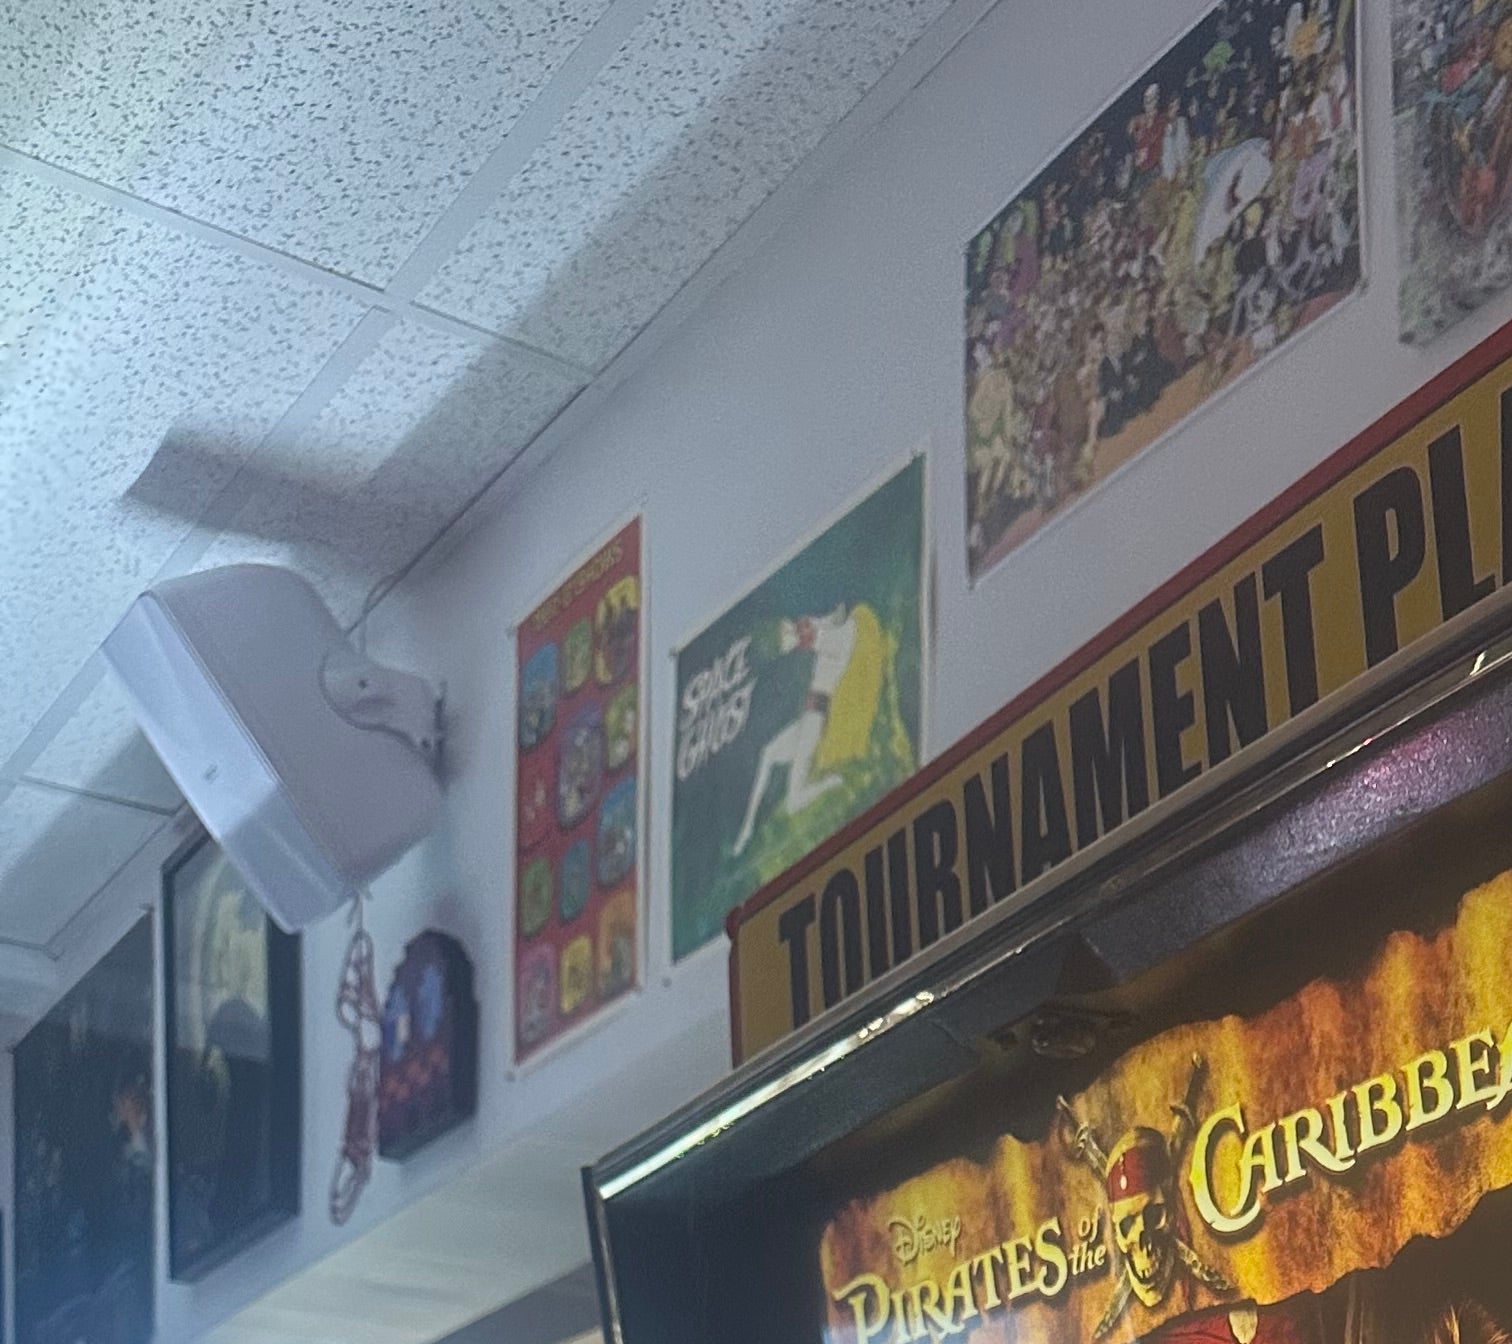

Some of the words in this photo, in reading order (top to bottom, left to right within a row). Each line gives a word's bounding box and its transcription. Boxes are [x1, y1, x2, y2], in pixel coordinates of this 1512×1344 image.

[779, 524, 1325, 1029] TOURNAMENT
[1078, 1204, 1103, 1243] of
[1068, 1242, 1106, 1277] the
